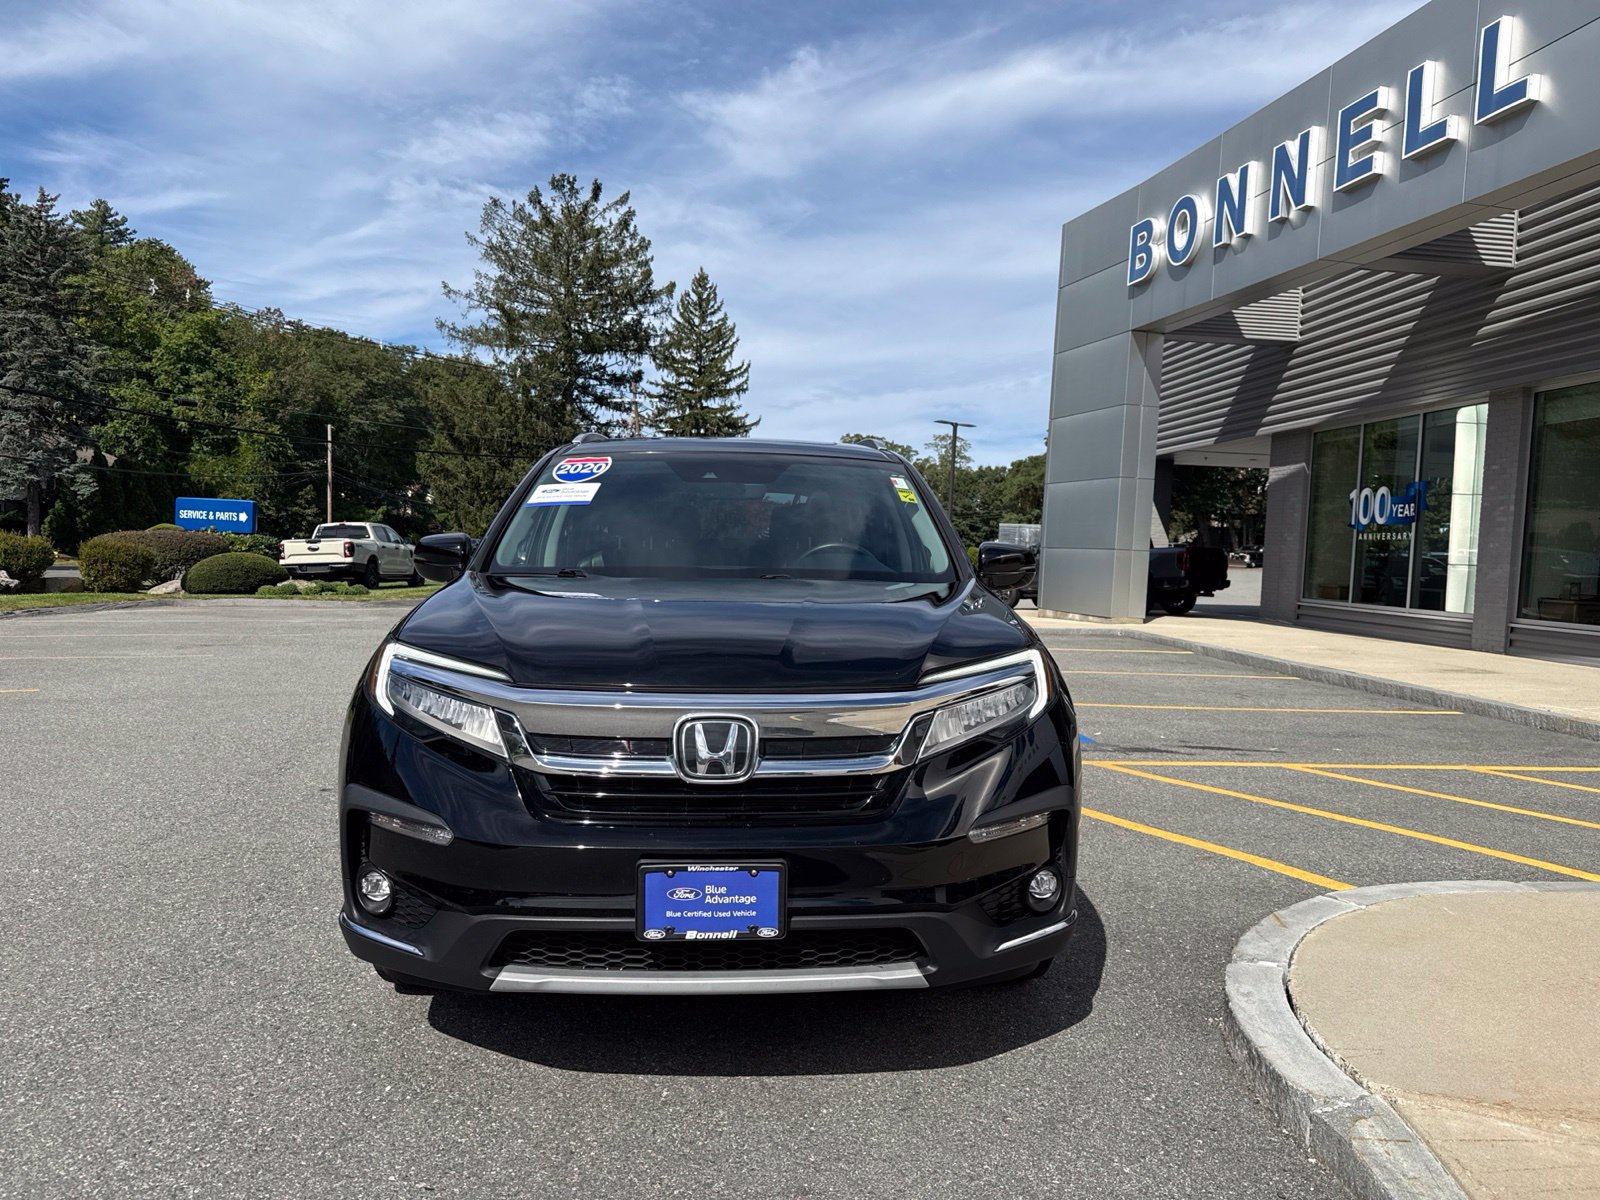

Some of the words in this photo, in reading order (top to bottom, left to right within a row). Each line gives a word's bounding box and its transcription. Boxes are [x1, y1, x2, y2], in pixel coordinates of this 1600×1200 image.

[1127, 15, 1542, 287] BONNELL
[556, 462, 607, 475] 2020
[1349, 486, 1391, 525] 100
[1392, 503, 1415, 517] YEAR
[179, 509, 207, 519] SERVICE
[208, 511, 214, 520] &
[215, 511, 237, 521] PARTS
[1358, 532, 1413, 541] ANNIVERSARY
[672, 888, 697, 899] Ford
[705, 885, 727, 894] Blue
[704, 895, 757, 904] Advantage
[732, 909, 757, 917] Vehicle
[685, 930, 738, 939] Bonnell
